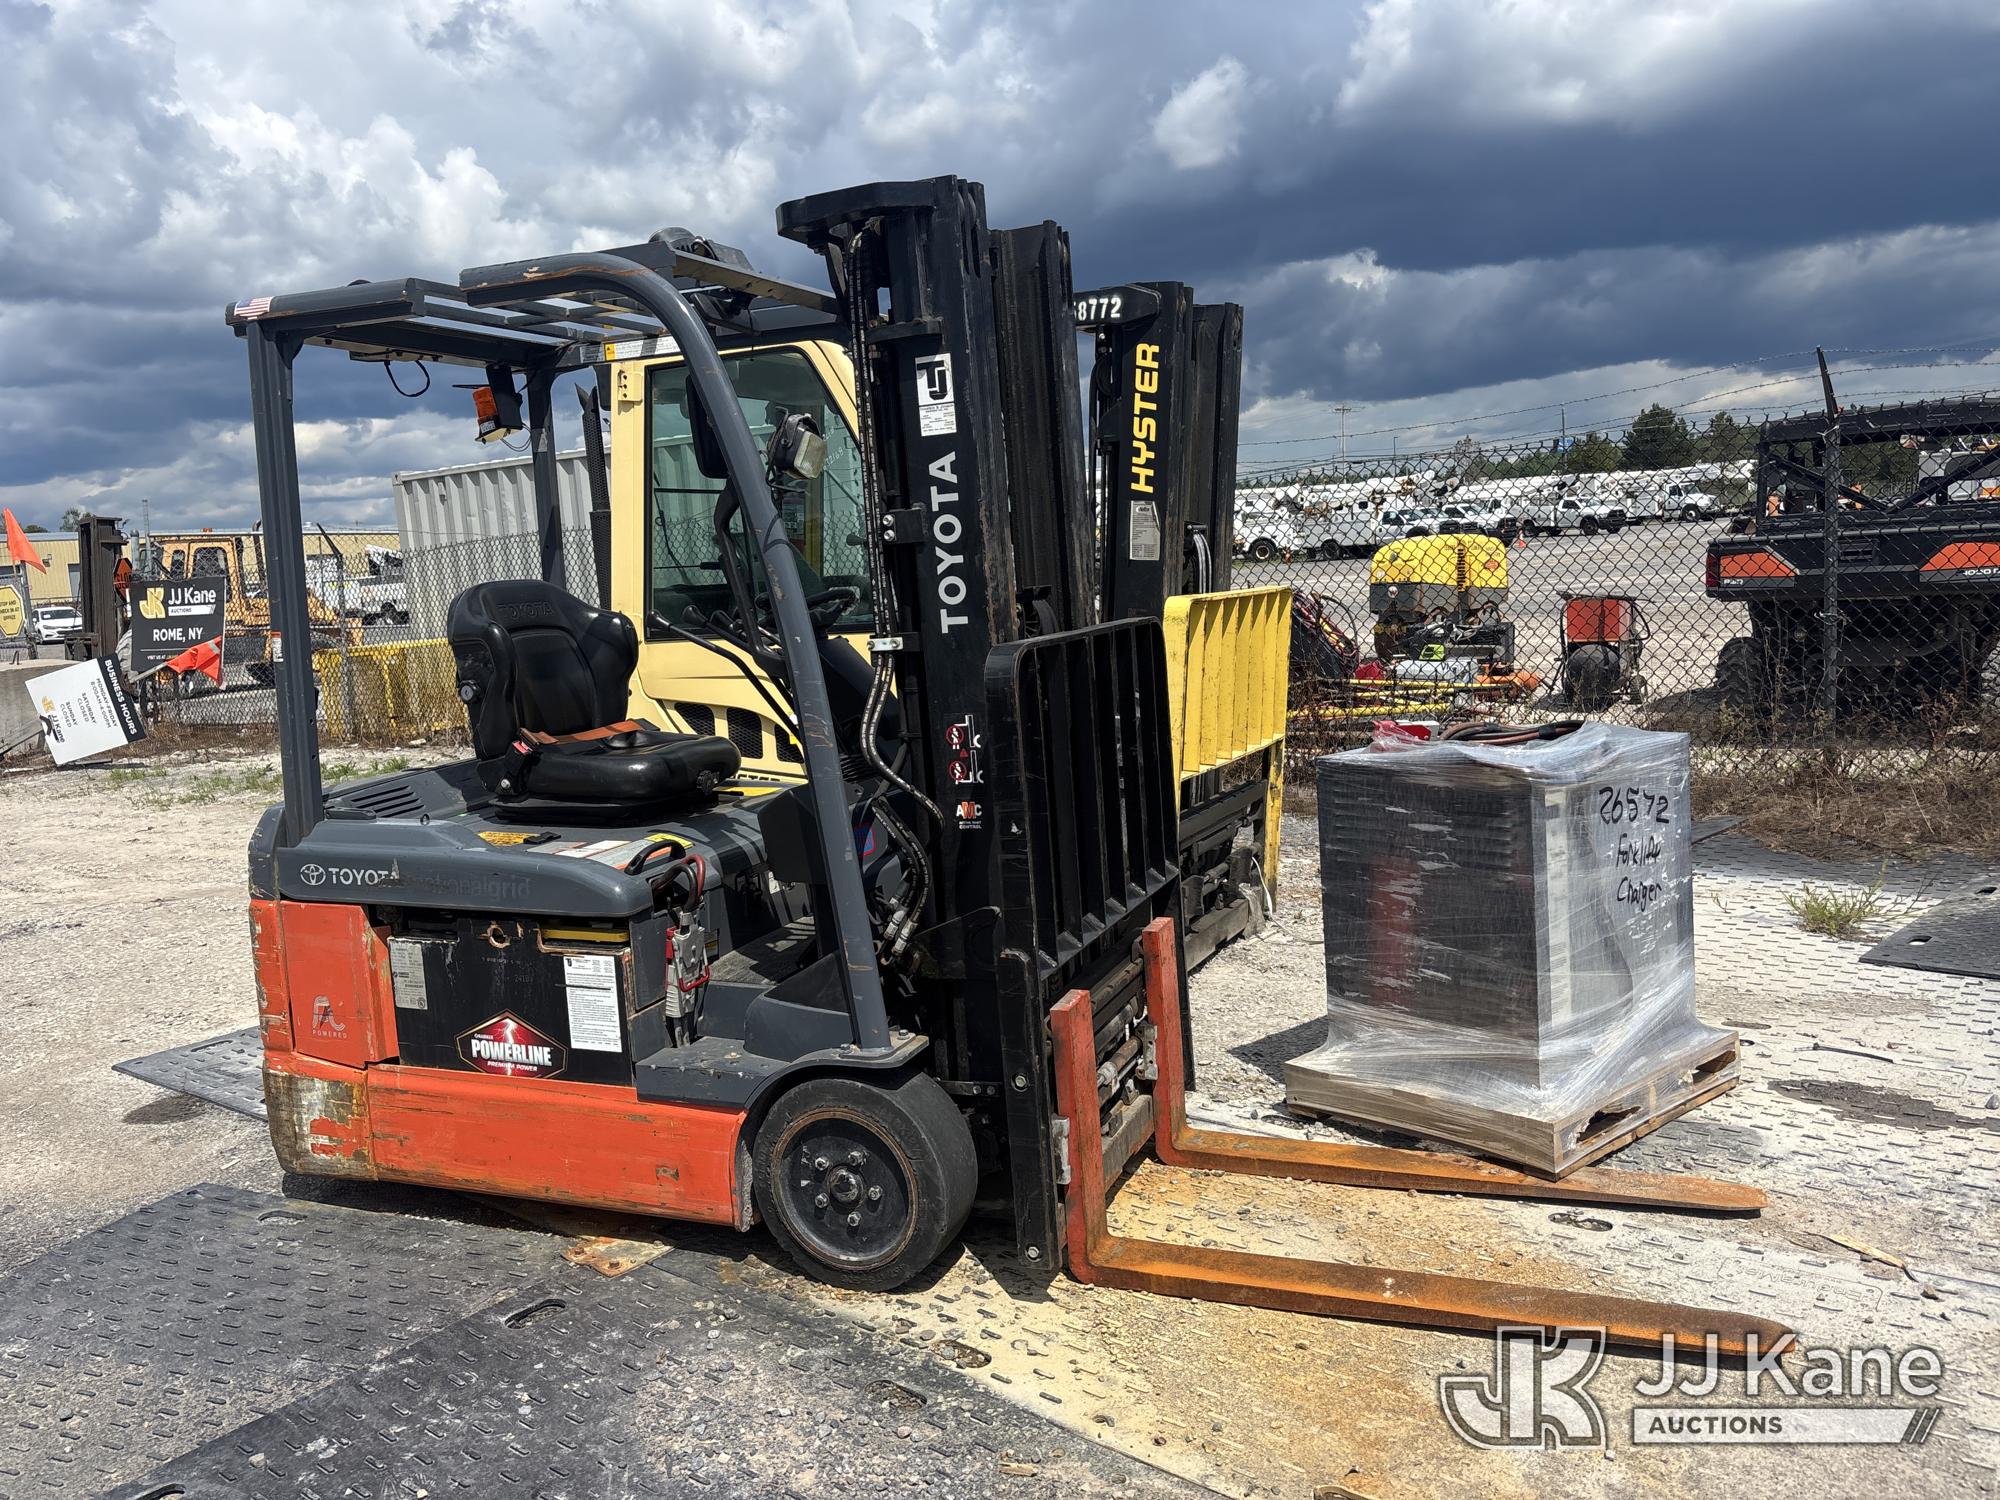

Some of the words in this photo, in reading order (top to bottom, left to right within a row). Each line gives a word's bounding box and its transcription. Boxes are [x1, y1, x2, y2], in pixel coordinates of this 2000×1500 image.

[1130, 343, 1160, 494] HYSTER
[928, 451, 968, 634] TOYOTA
[184, 587, 216, 604] Kane
[153, 628, 186, 642] ROME,
[188, 627, 203, 640] NY
[78, 698, 90, 722] CLOSED
[82, 692, 97, 724] SATURDAY
[105, 659, 125, 705] BUSINESS
[120, 703, 137, 735] HOURS
[60, 703, 72, 728] CLOSED
[66, 701, 78, 726] SUNDAY
[1599, 786, 1669, 825] 26572
[1617, 876, 1662, 912] Charger
[471, 1039, 552, 1067] POWERLINE
[487, 1060, 515, 1069] PREMIUM
[516, 1063, 538, 1072] POWER
